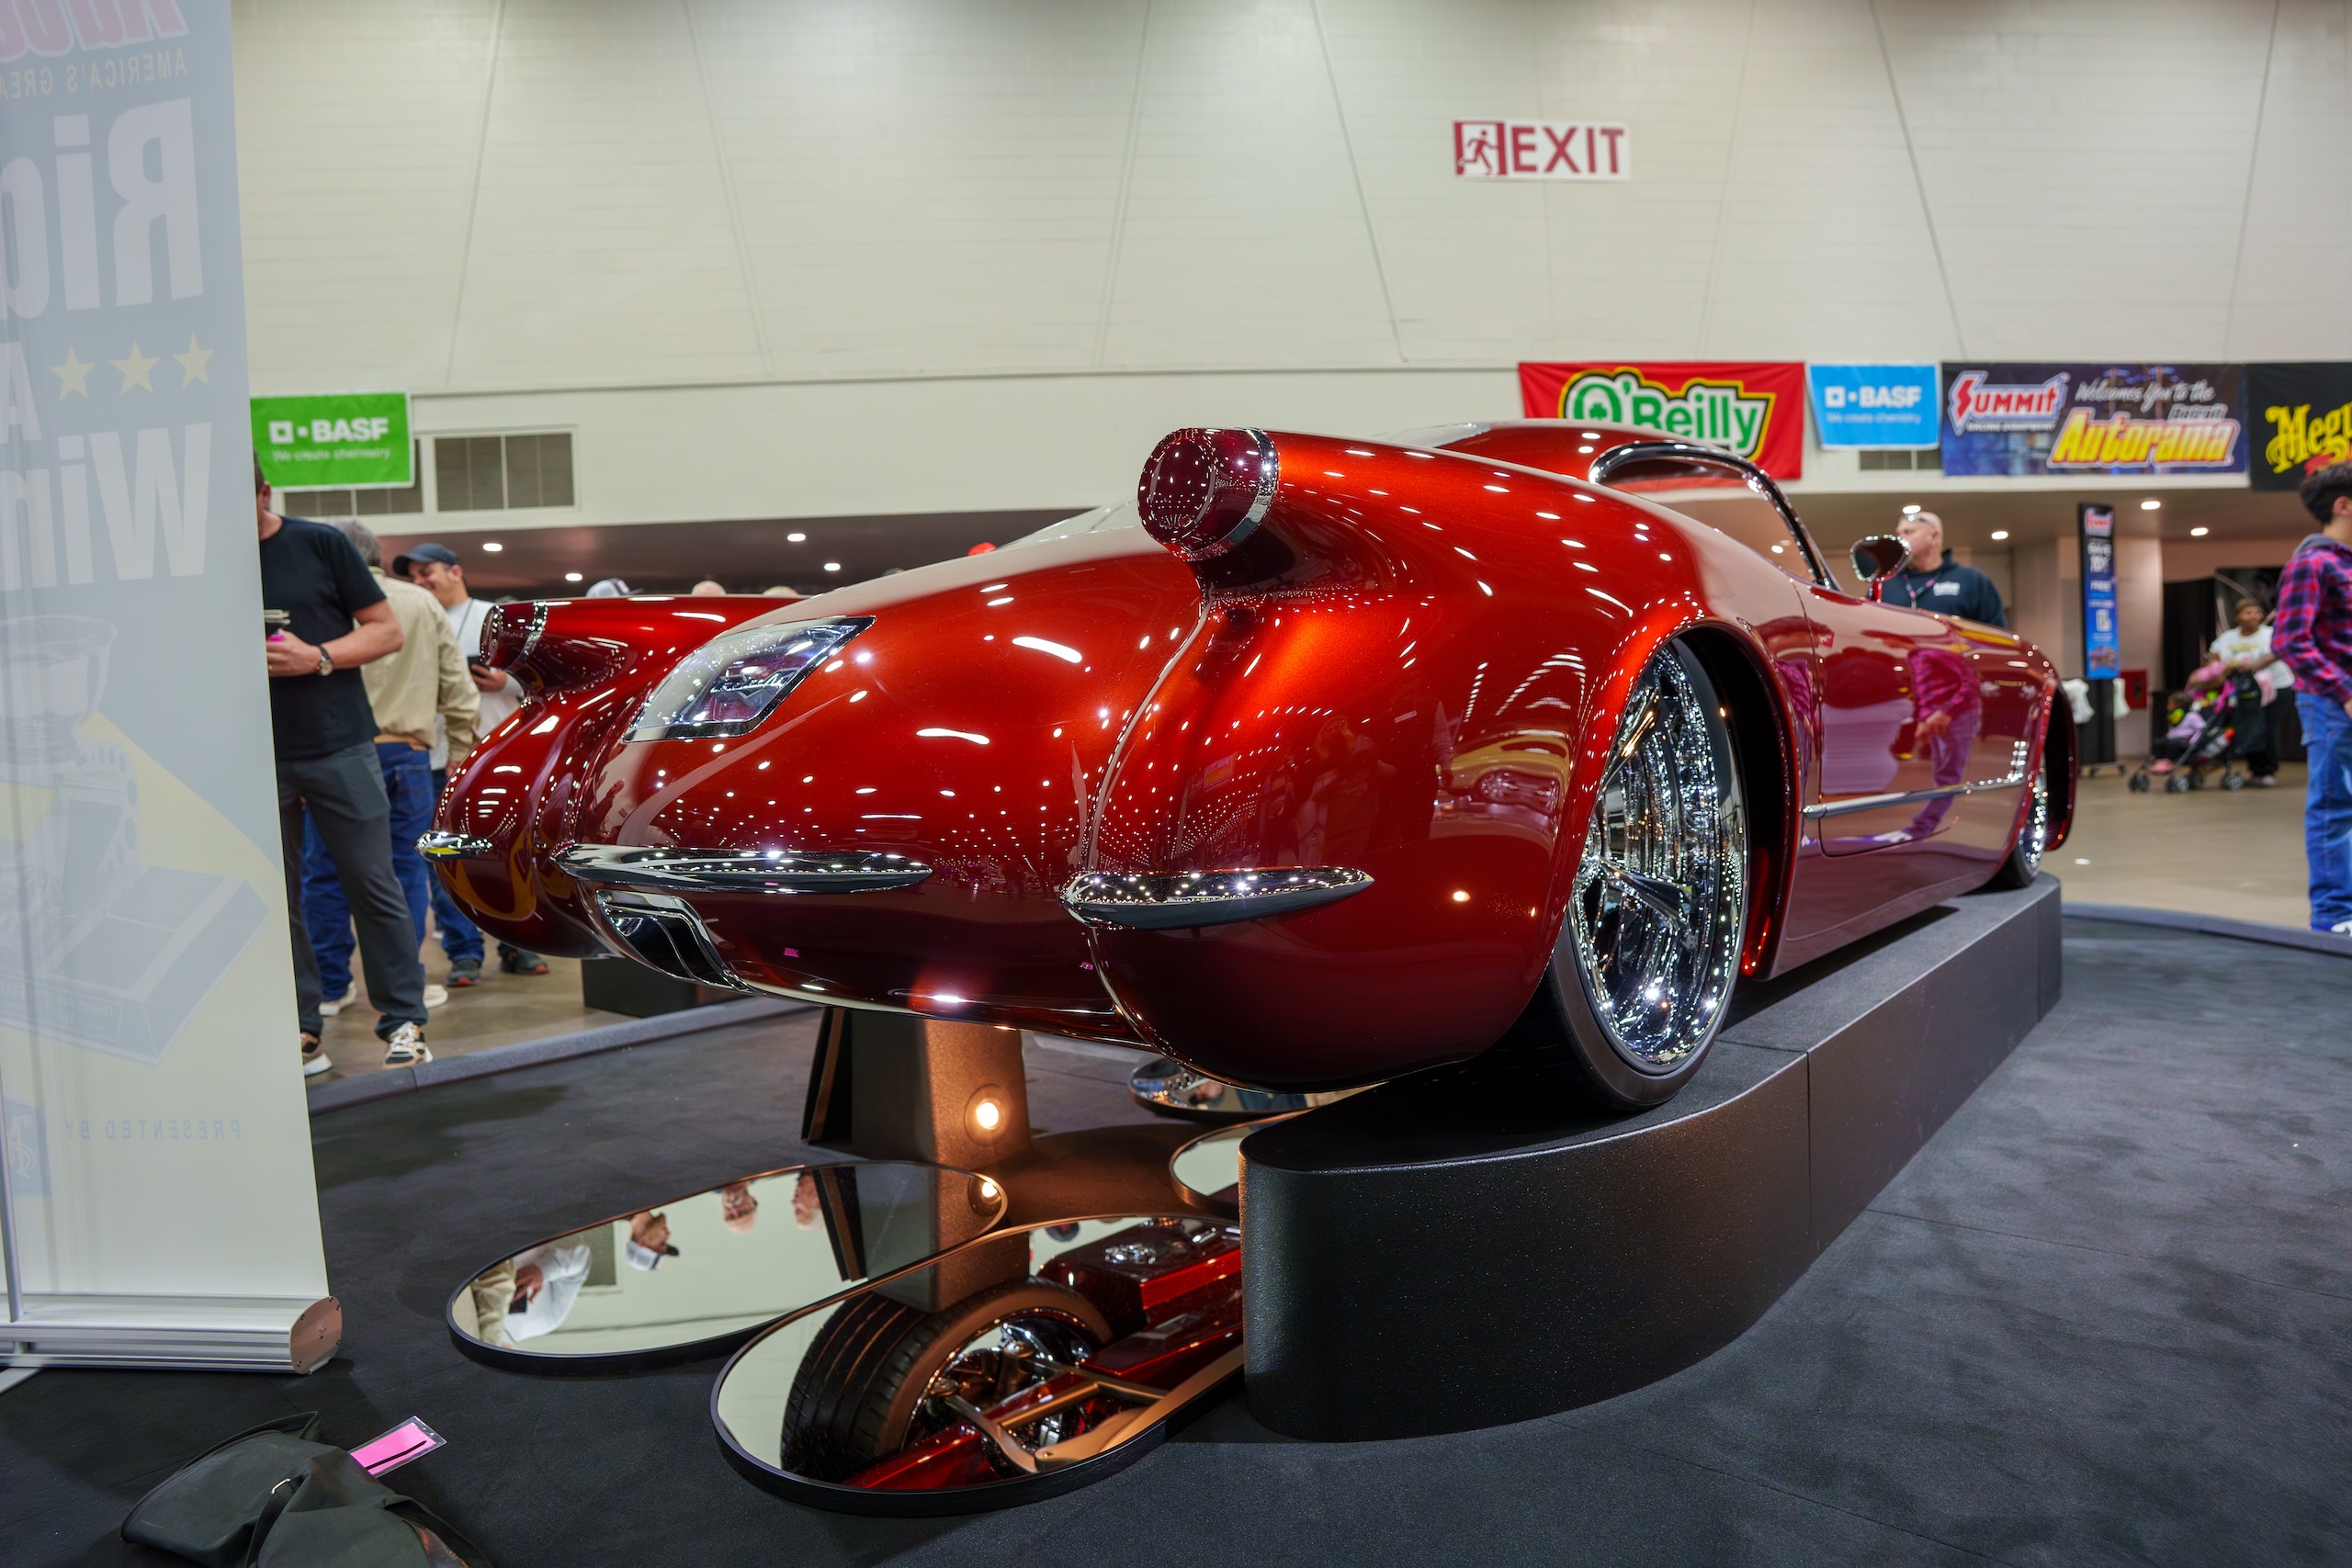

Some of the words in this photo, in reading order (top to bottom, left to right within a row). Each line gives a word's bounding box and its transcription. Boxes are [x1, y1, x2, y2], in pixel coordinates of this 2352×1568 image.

[1511, 126, 1624, 174] EXIT
[1573, 379, 1758, 448] O'Reilly
[1859, 386, 1922, 408] BASF
[311, 418, 389, 442] BASF
[2050, 410, 2237, 465] Autorama
